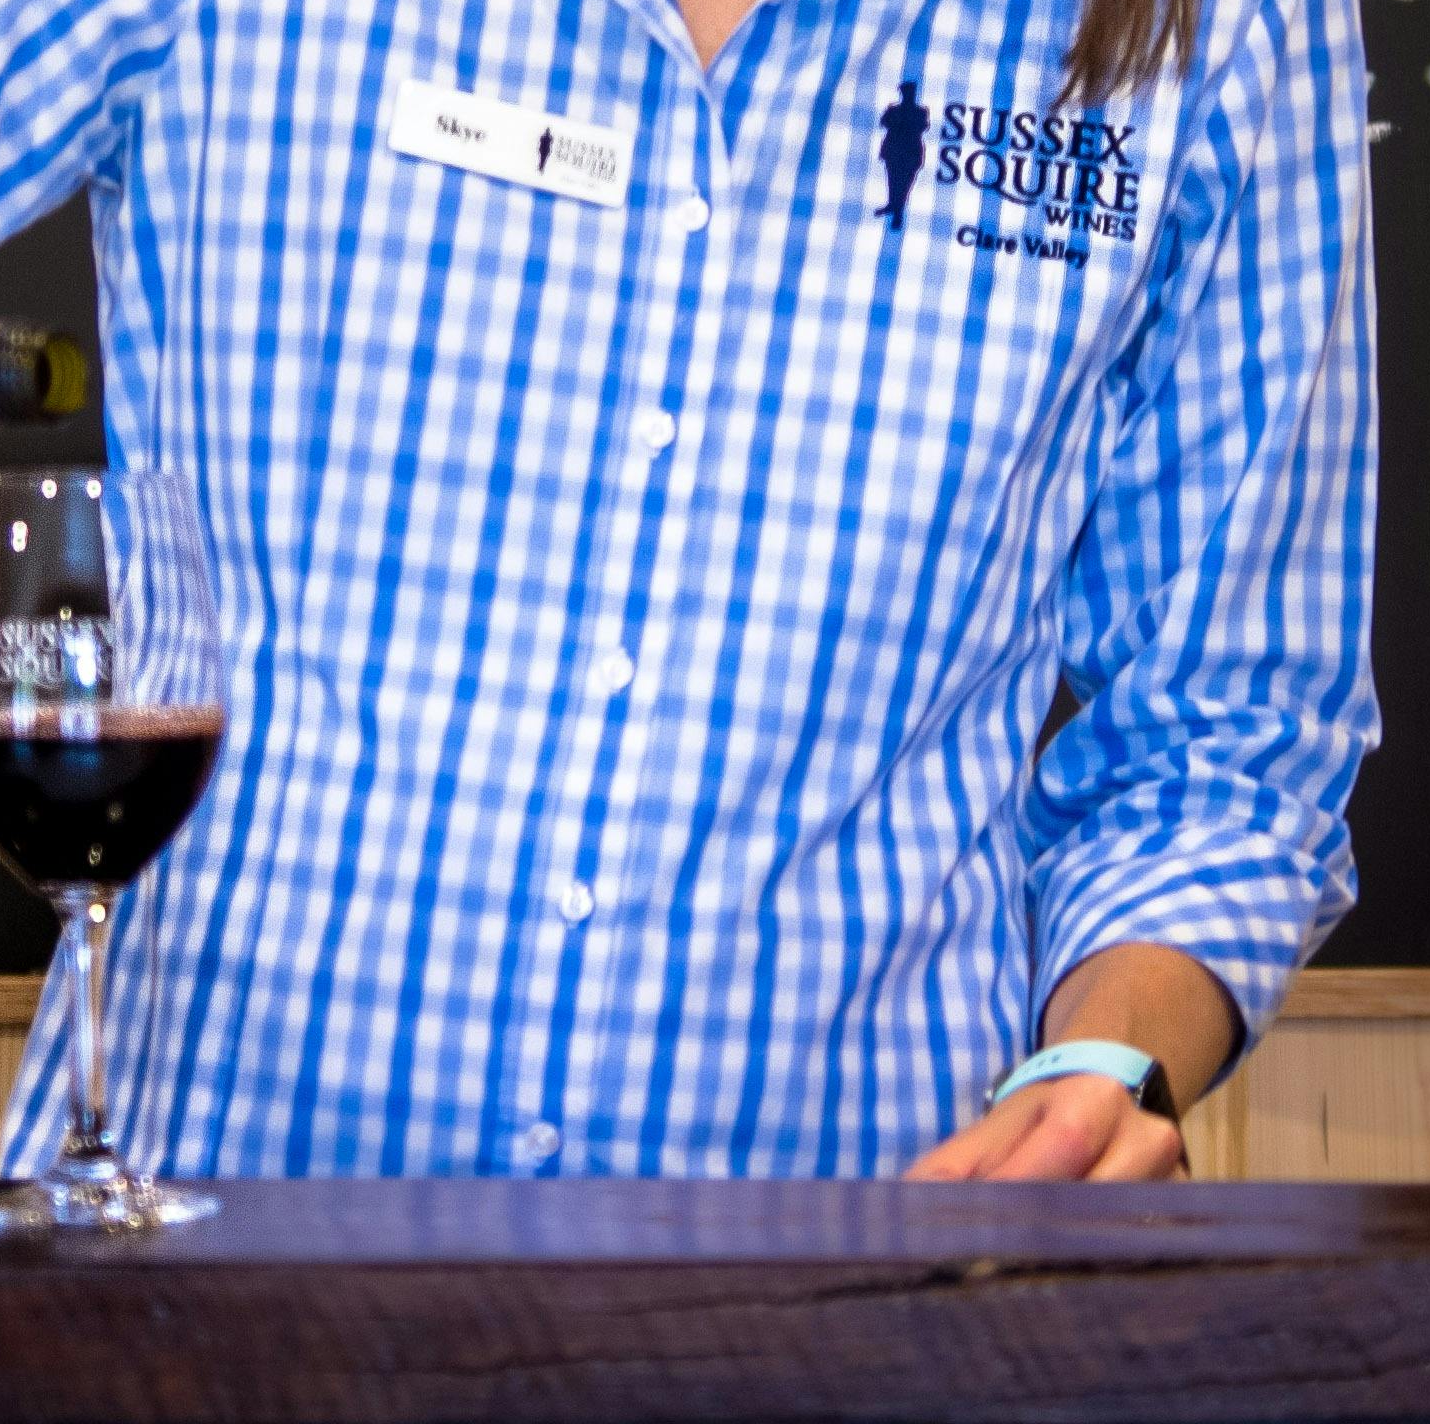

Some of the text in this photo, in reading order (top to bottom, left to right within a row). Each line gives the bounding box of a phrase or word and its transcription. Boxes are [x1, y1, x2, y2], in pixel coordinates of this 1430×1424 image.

[941, 103, 1135, 168] SUSSEX
[936, 145, 1139, 213] SQUIRE
[957, 225, 1091, 269] Clare Valley
[1045, 206, 1138, 243] WINES
